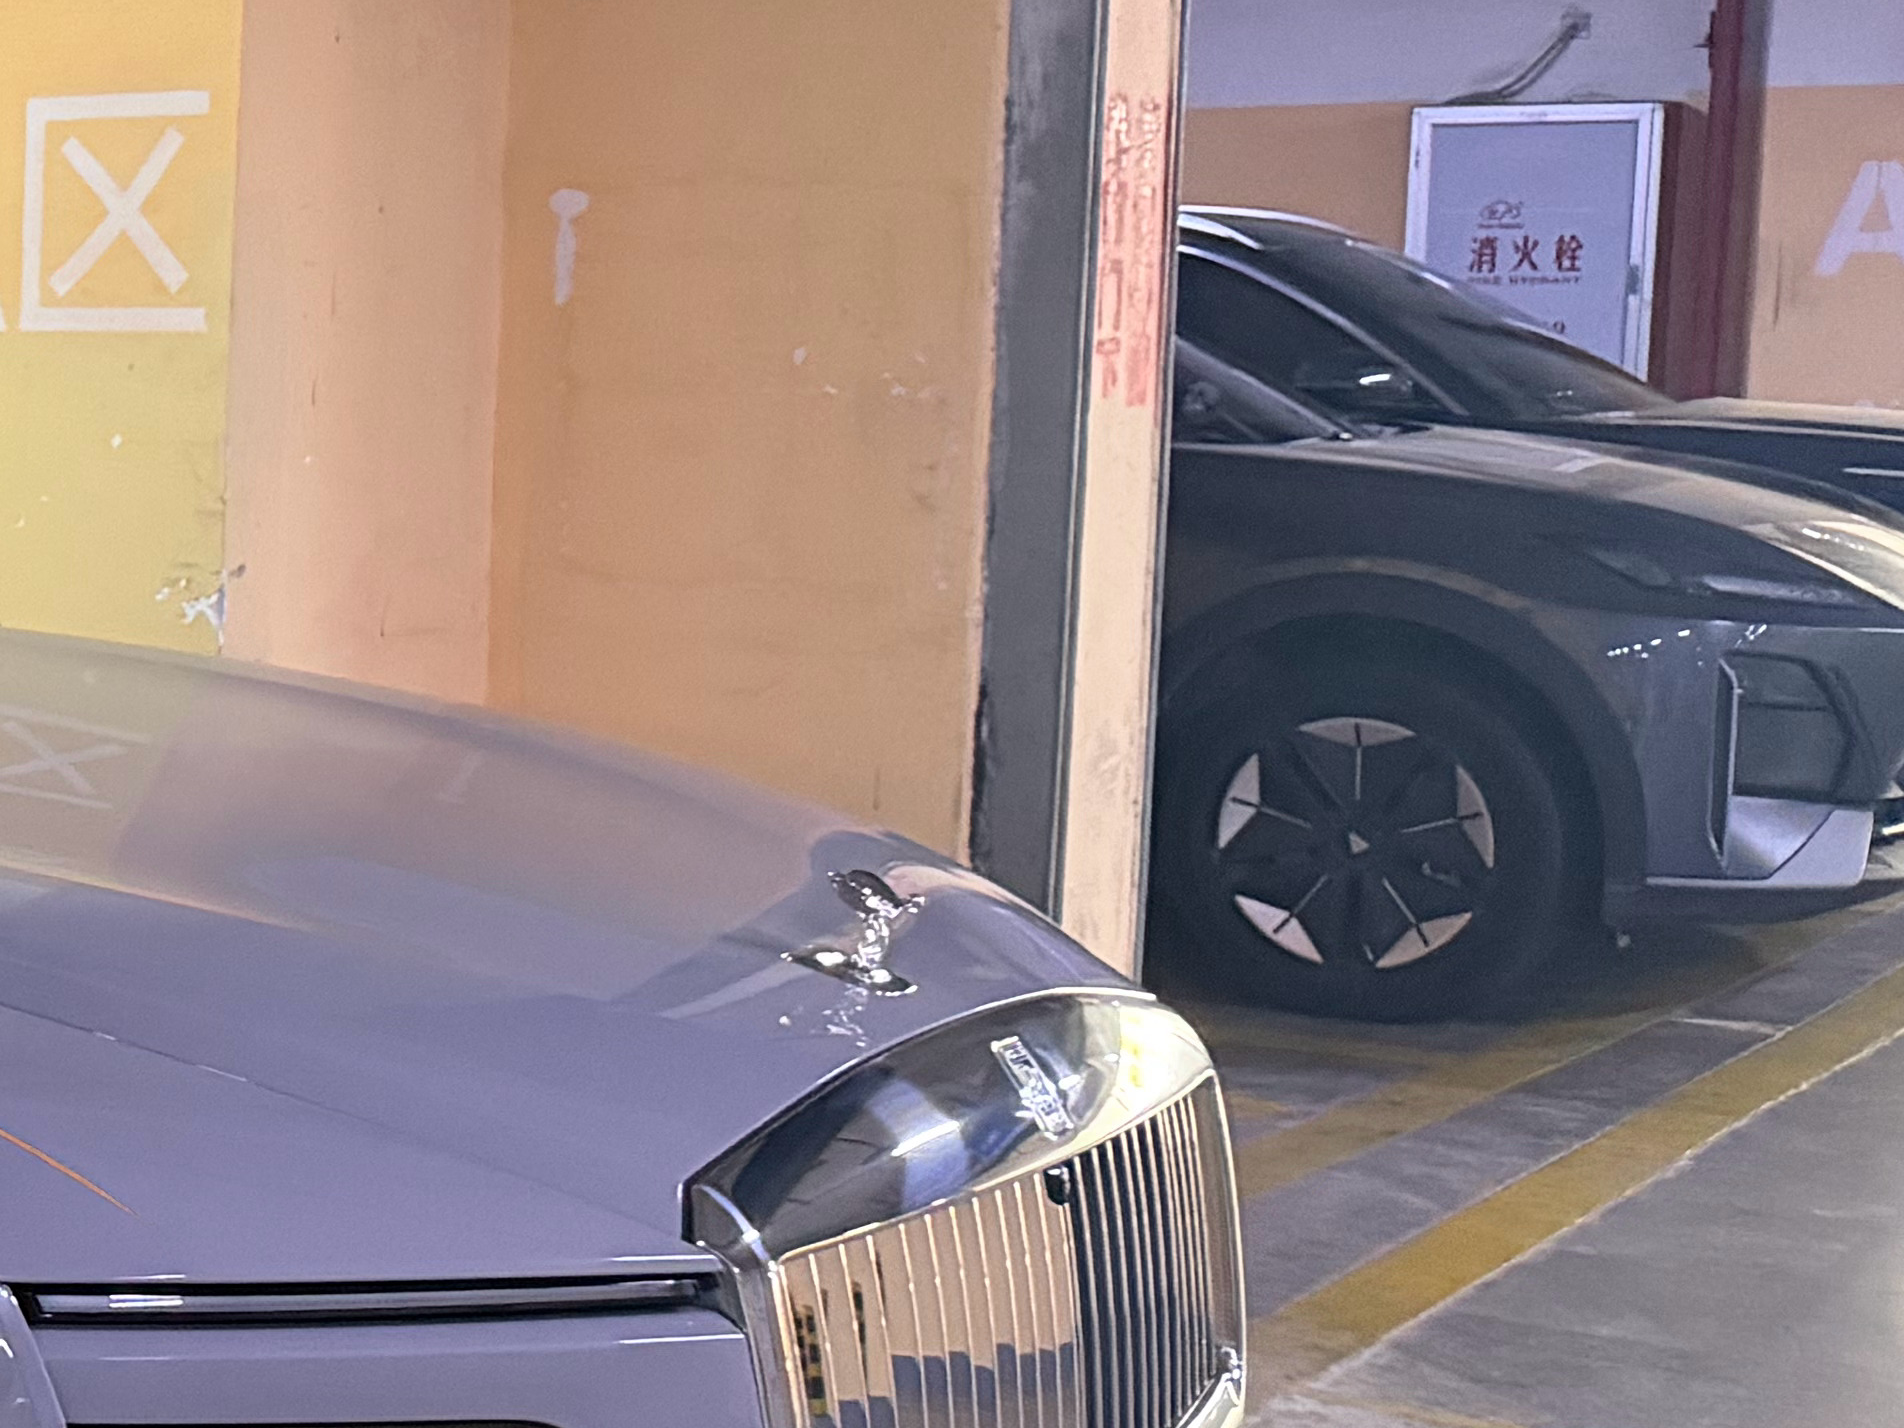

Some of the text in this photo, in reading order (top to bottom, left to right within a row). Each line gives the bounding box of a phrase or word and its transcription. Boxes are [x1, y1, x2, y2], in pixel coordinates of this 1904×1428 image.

[1468, 234, 1584, 273] 消火栓
[1814, 160, 1904, 277] A
